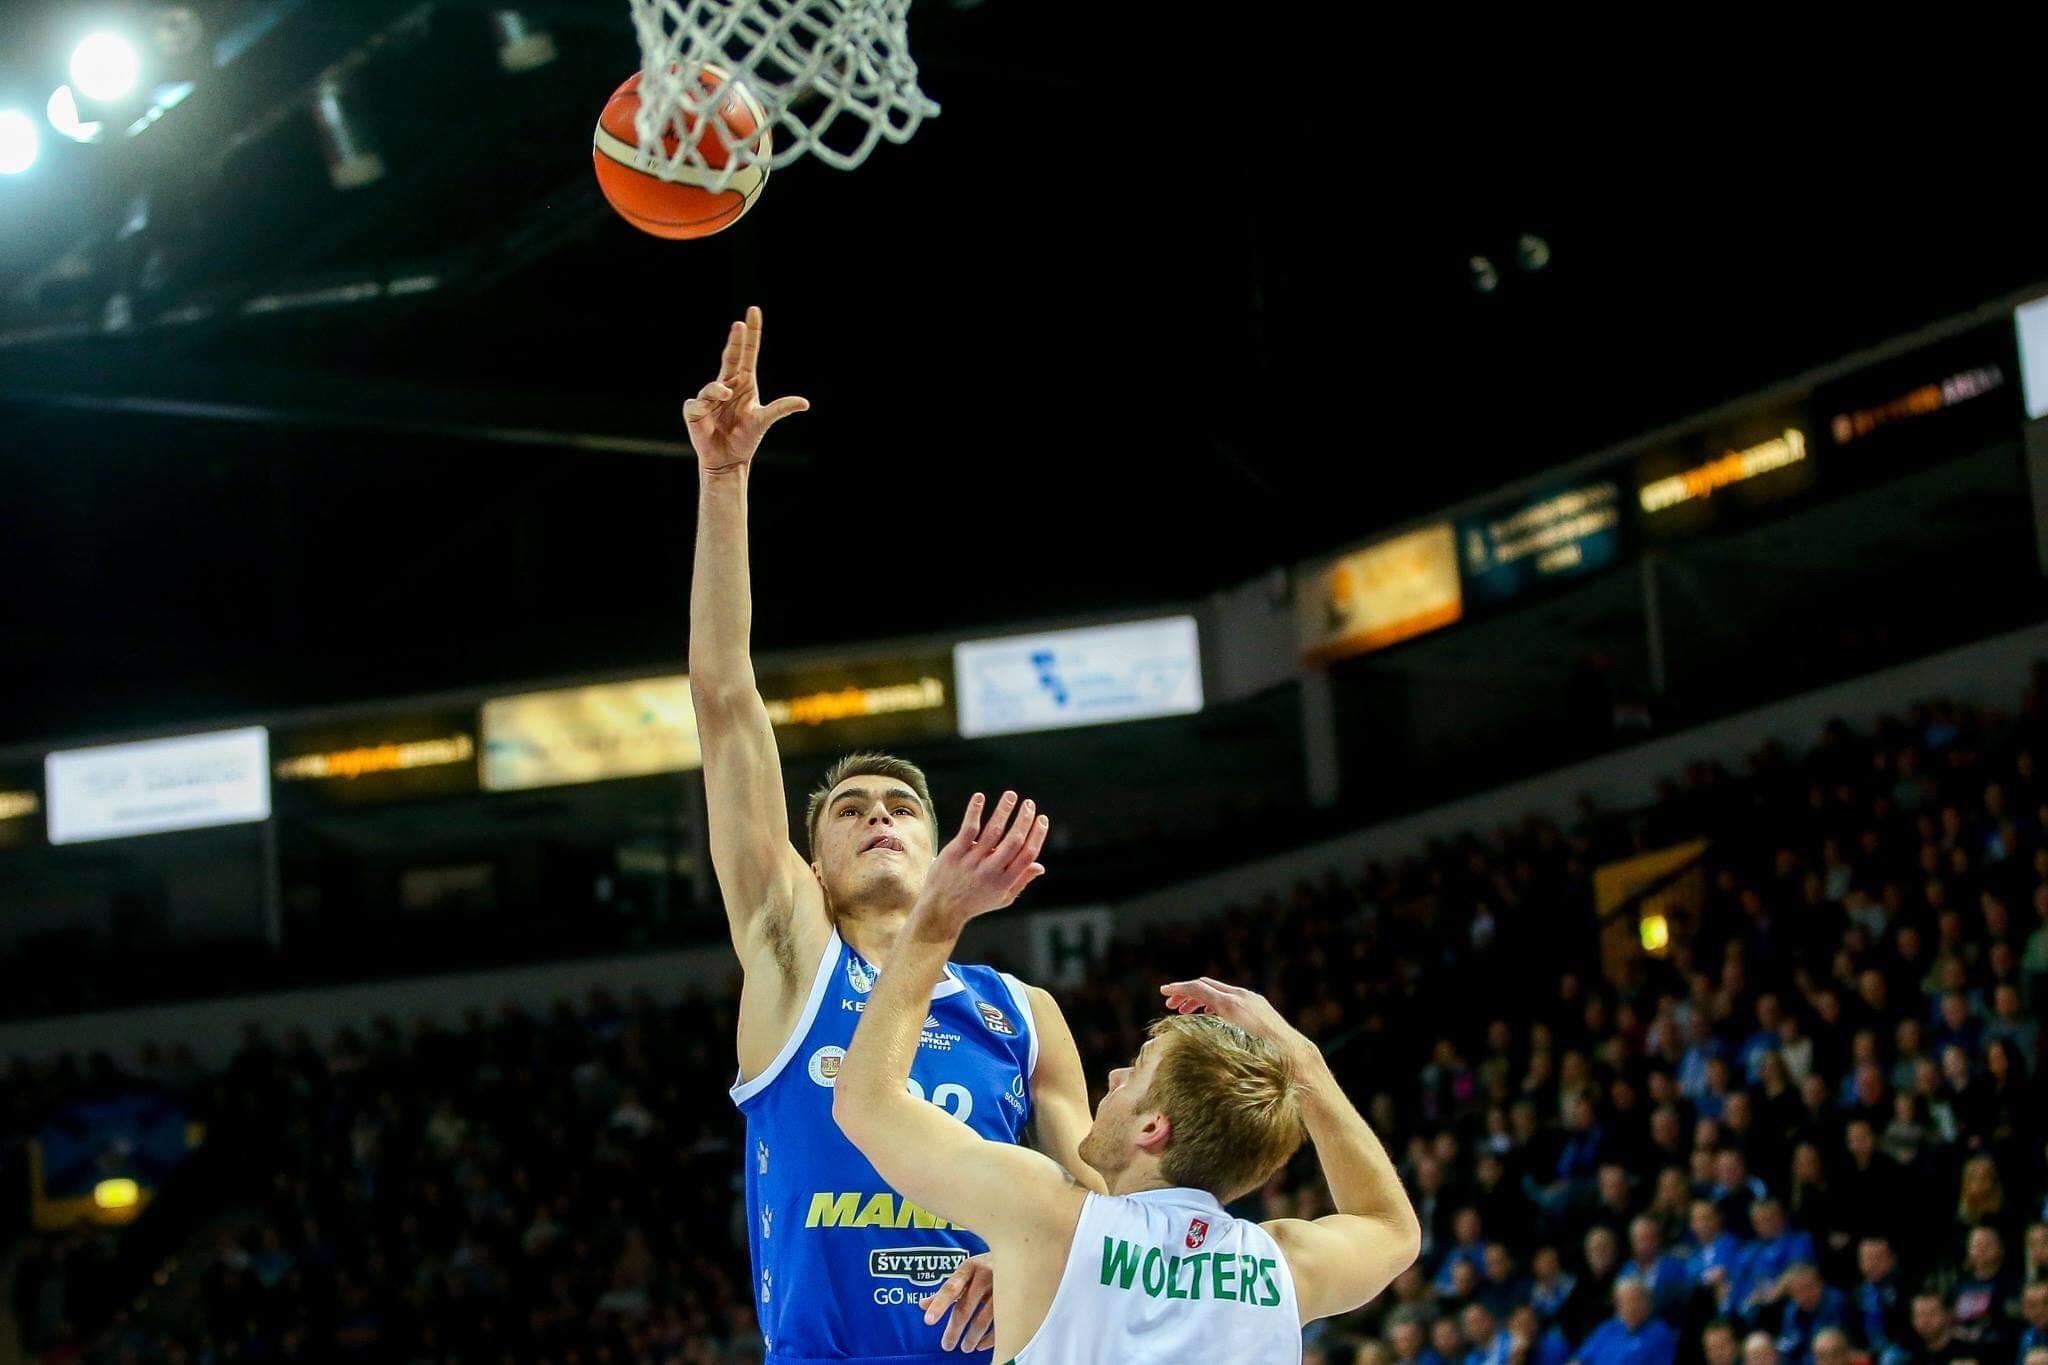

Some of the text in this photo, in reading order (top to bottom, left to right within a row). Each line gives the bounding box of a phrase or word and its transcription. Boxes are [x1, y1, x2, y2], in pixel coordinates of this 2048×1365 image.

[877, 1253, 966, 1271] ŠVYTURY
[1100, 1235, 1281, 1307] WOLTERS
[916, 1272, 936, 1280] 1784
[873, 1287, 904, 1305] GO
